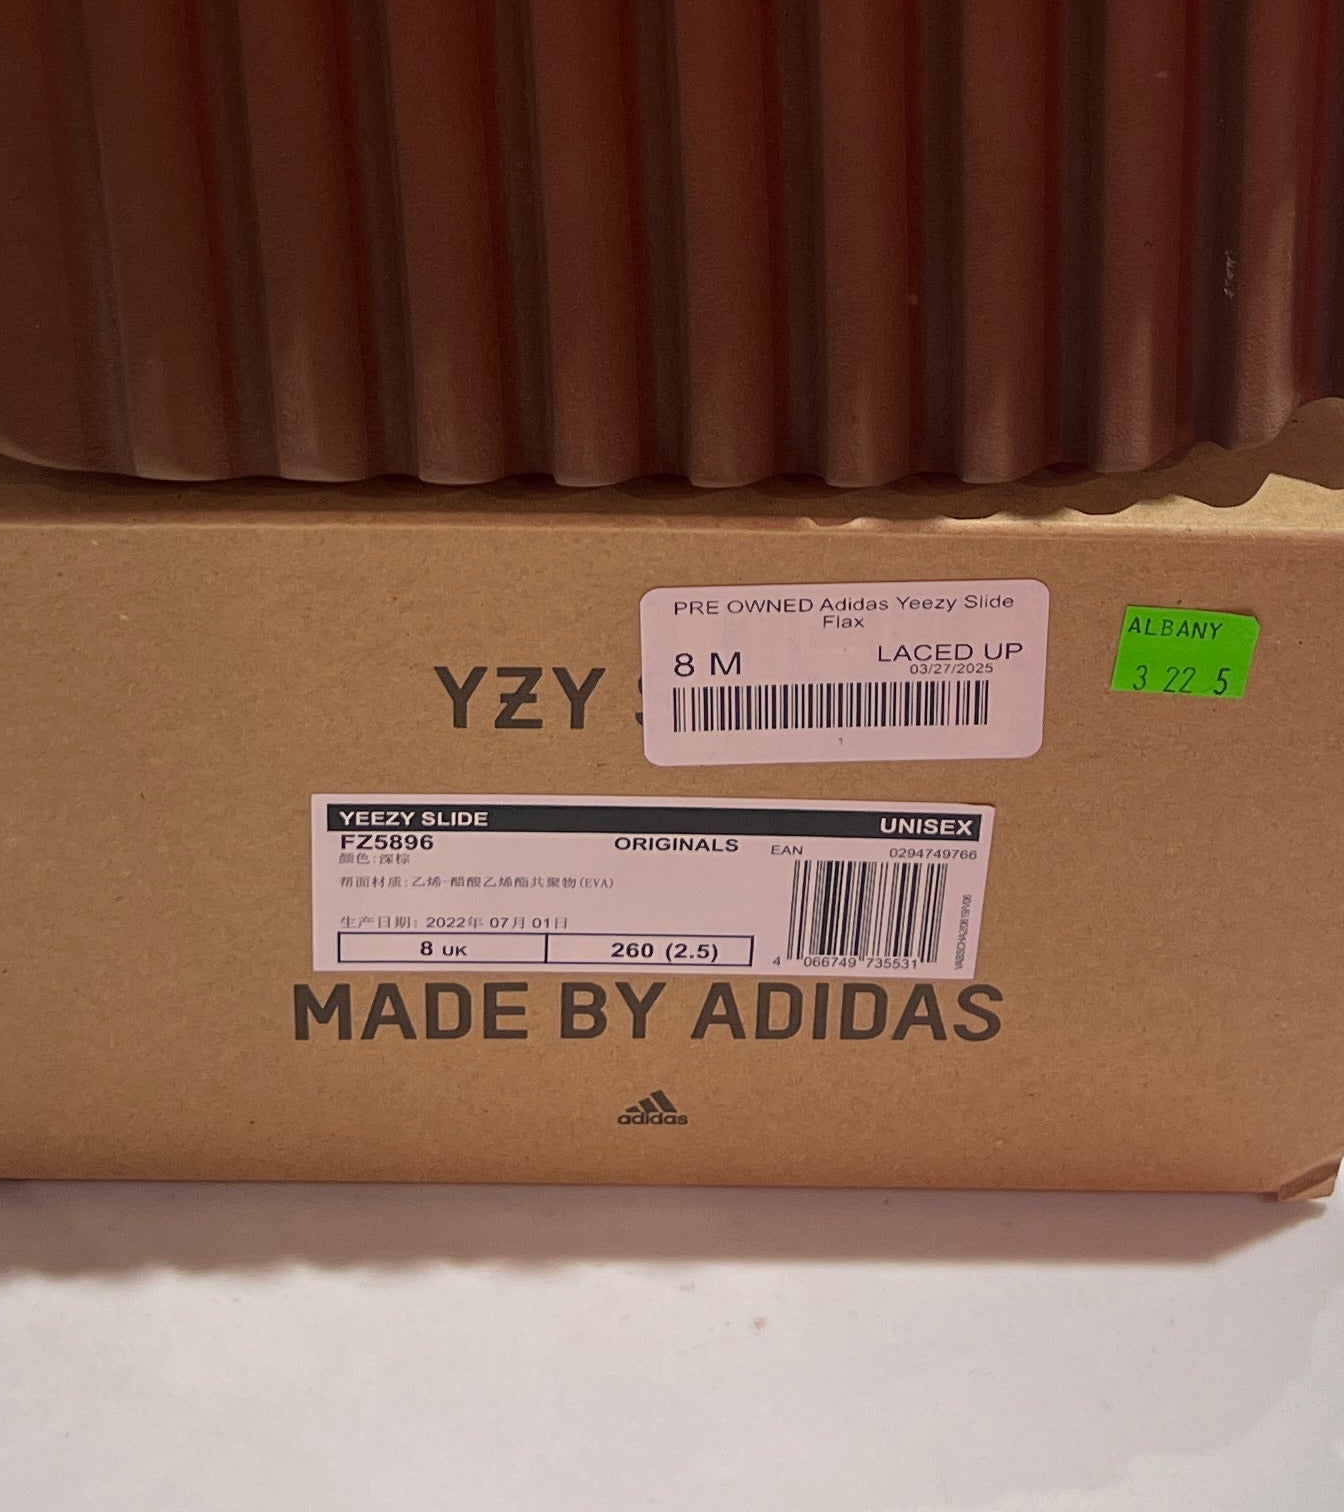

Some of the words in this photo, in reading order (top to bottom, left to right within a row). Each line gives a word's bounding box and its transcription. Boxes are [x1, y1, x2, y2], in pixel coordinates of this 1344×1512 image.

[673, 600, 720, 616] PRE
[726, 597, 815, 614] OWNED
[819, 596, 890, 612] Adidas
[896, 595, 958, 613] Yeezy
[964, 594, 1015, 610] Slide
[822, 614, 866, 630] Flax
[1127, 616, 1224, 640] ALBANY
[877, 644, 974, 663] LACED
[983, 642, 1025, 661] UP
[673, 652, 696, 678] 8
[709, 651, 743, 676] M
[908, 662, 995, 676] 03/27/2025
[1132, 664, 1149, 692] 3
[1162, 665, 1198, 694] 22
[1212, 667, 1232, 696] 5
[432, 666, 607, 730] YZY
[338, 810, 416, 828] YEEZY
[421, 810, 489, 828] SLIDE
[879, 817, 974, 837] UNISEX
[340, 834, 435, 851] FZ5896
[613, 836, 740, 853] ORIGINALS
[770, 844, 805, 856] EAN
[889, 847, 979, 861] 0294749766
[419, 940, 434, 957] 8
[442, 945, 468, 957] UK
[610, 942, 655, 959] 260
[664, 942, 720, 962] (2.5)
[772, 956, 782, 967] 4
[803, 956, 857, 969] 066749
[865, 957, 919, 970] 735531
[293, 981, 529, 1041] MADE
[559, 981, 667, 1040] BY
[689, 981, 1004, 1043] ADIDAS
[617, 1111, 689, 1125] adidas
